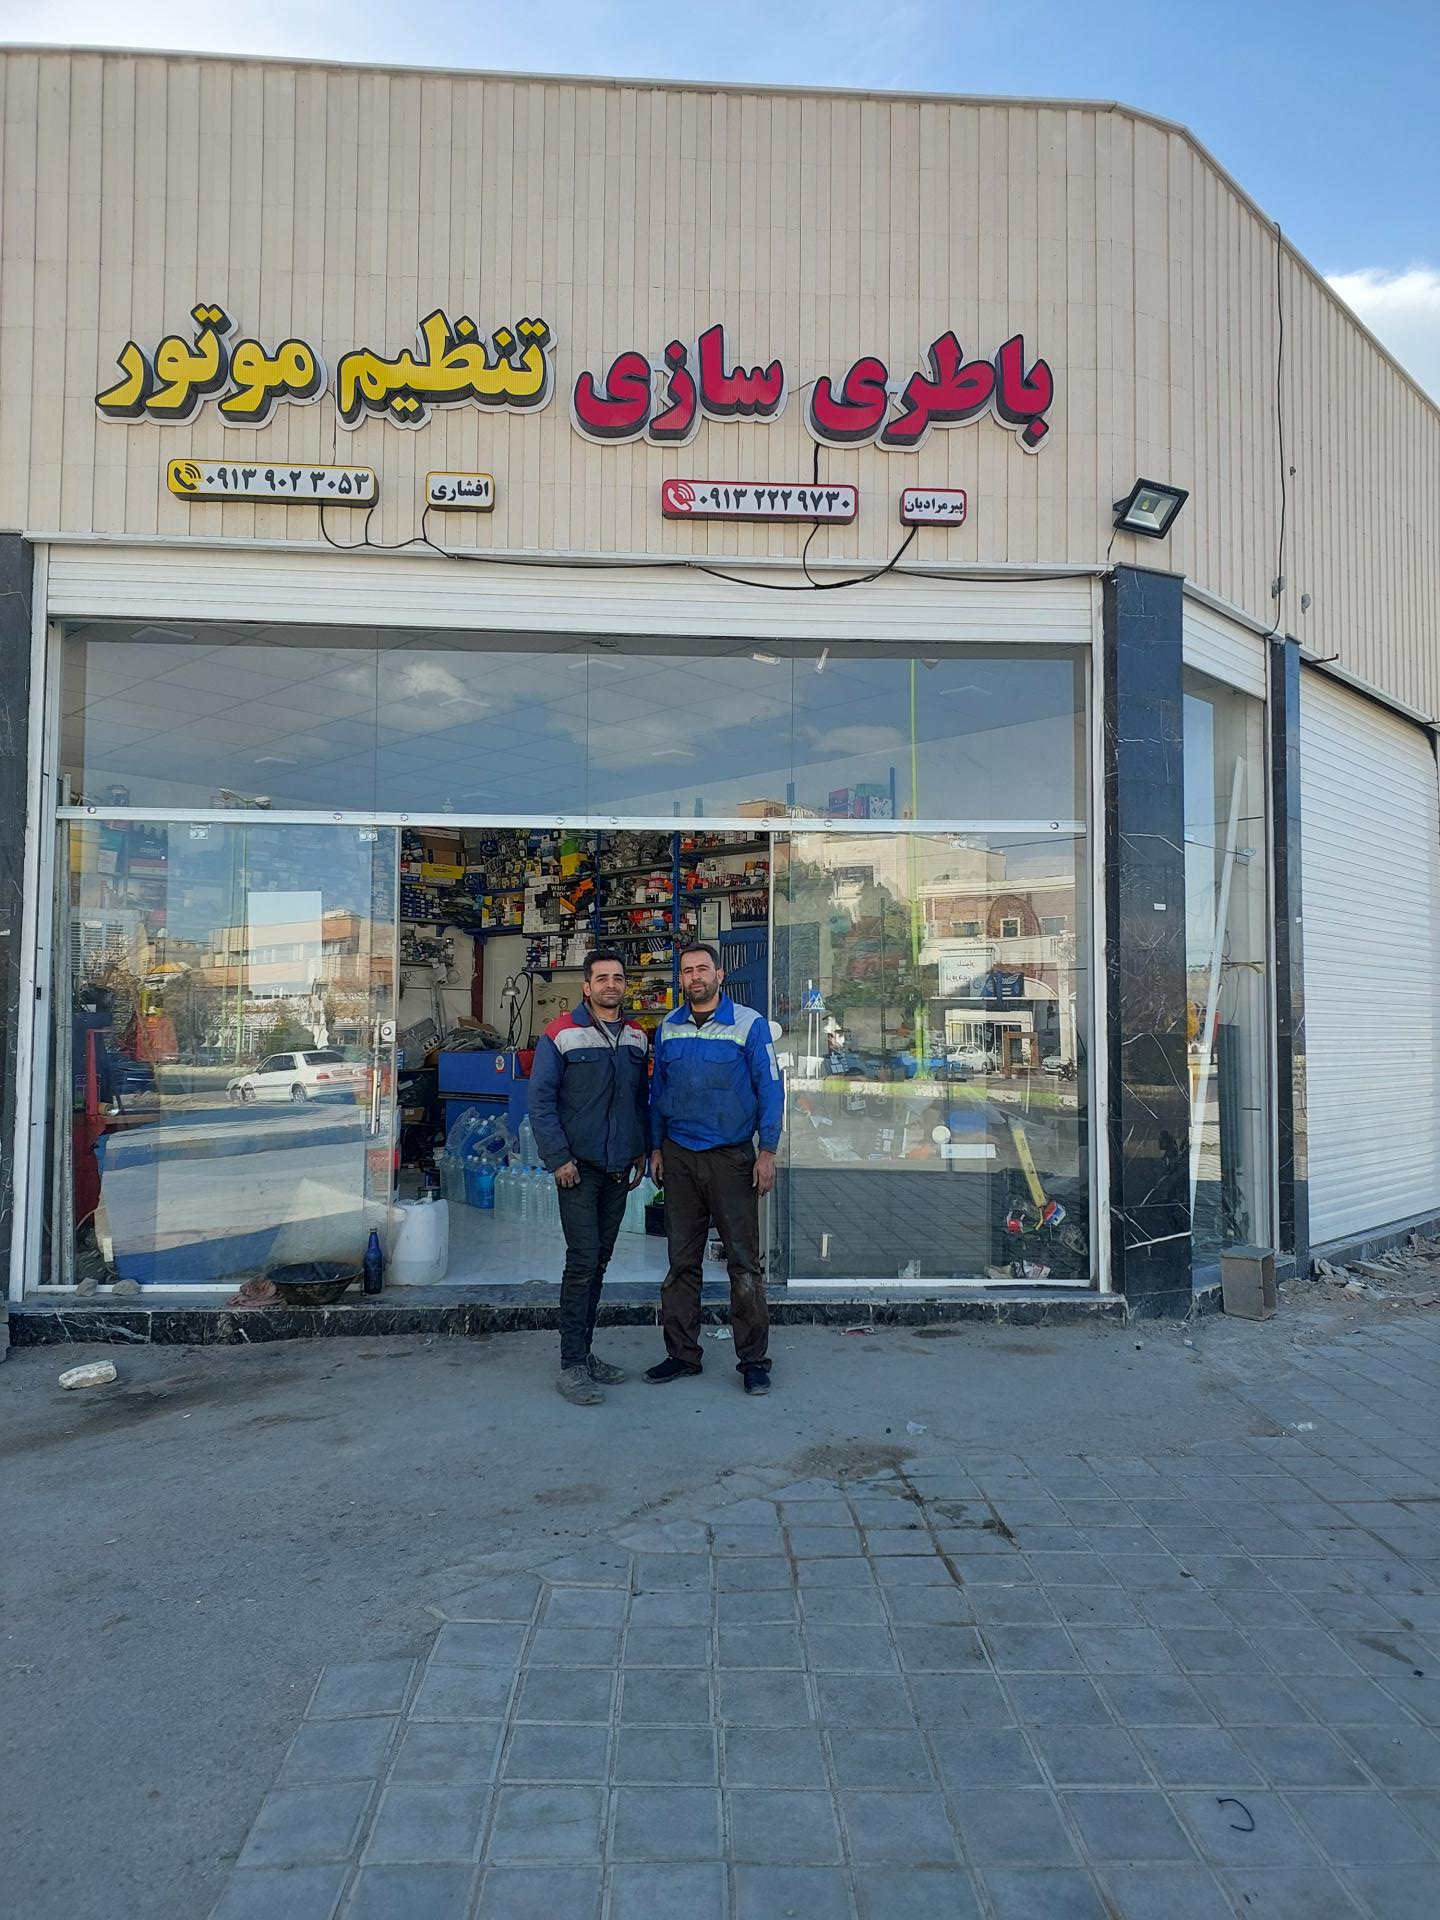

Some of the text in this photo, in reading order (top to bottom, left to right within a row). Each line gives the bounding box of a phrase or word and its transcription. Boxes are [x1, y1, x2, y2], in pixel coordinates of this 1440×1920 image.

[96, 304, 551, 424] تنظیم موتور
[574, 323, 1054, 447] باطری سازی
[431, 479, 489, 501] افشاری
